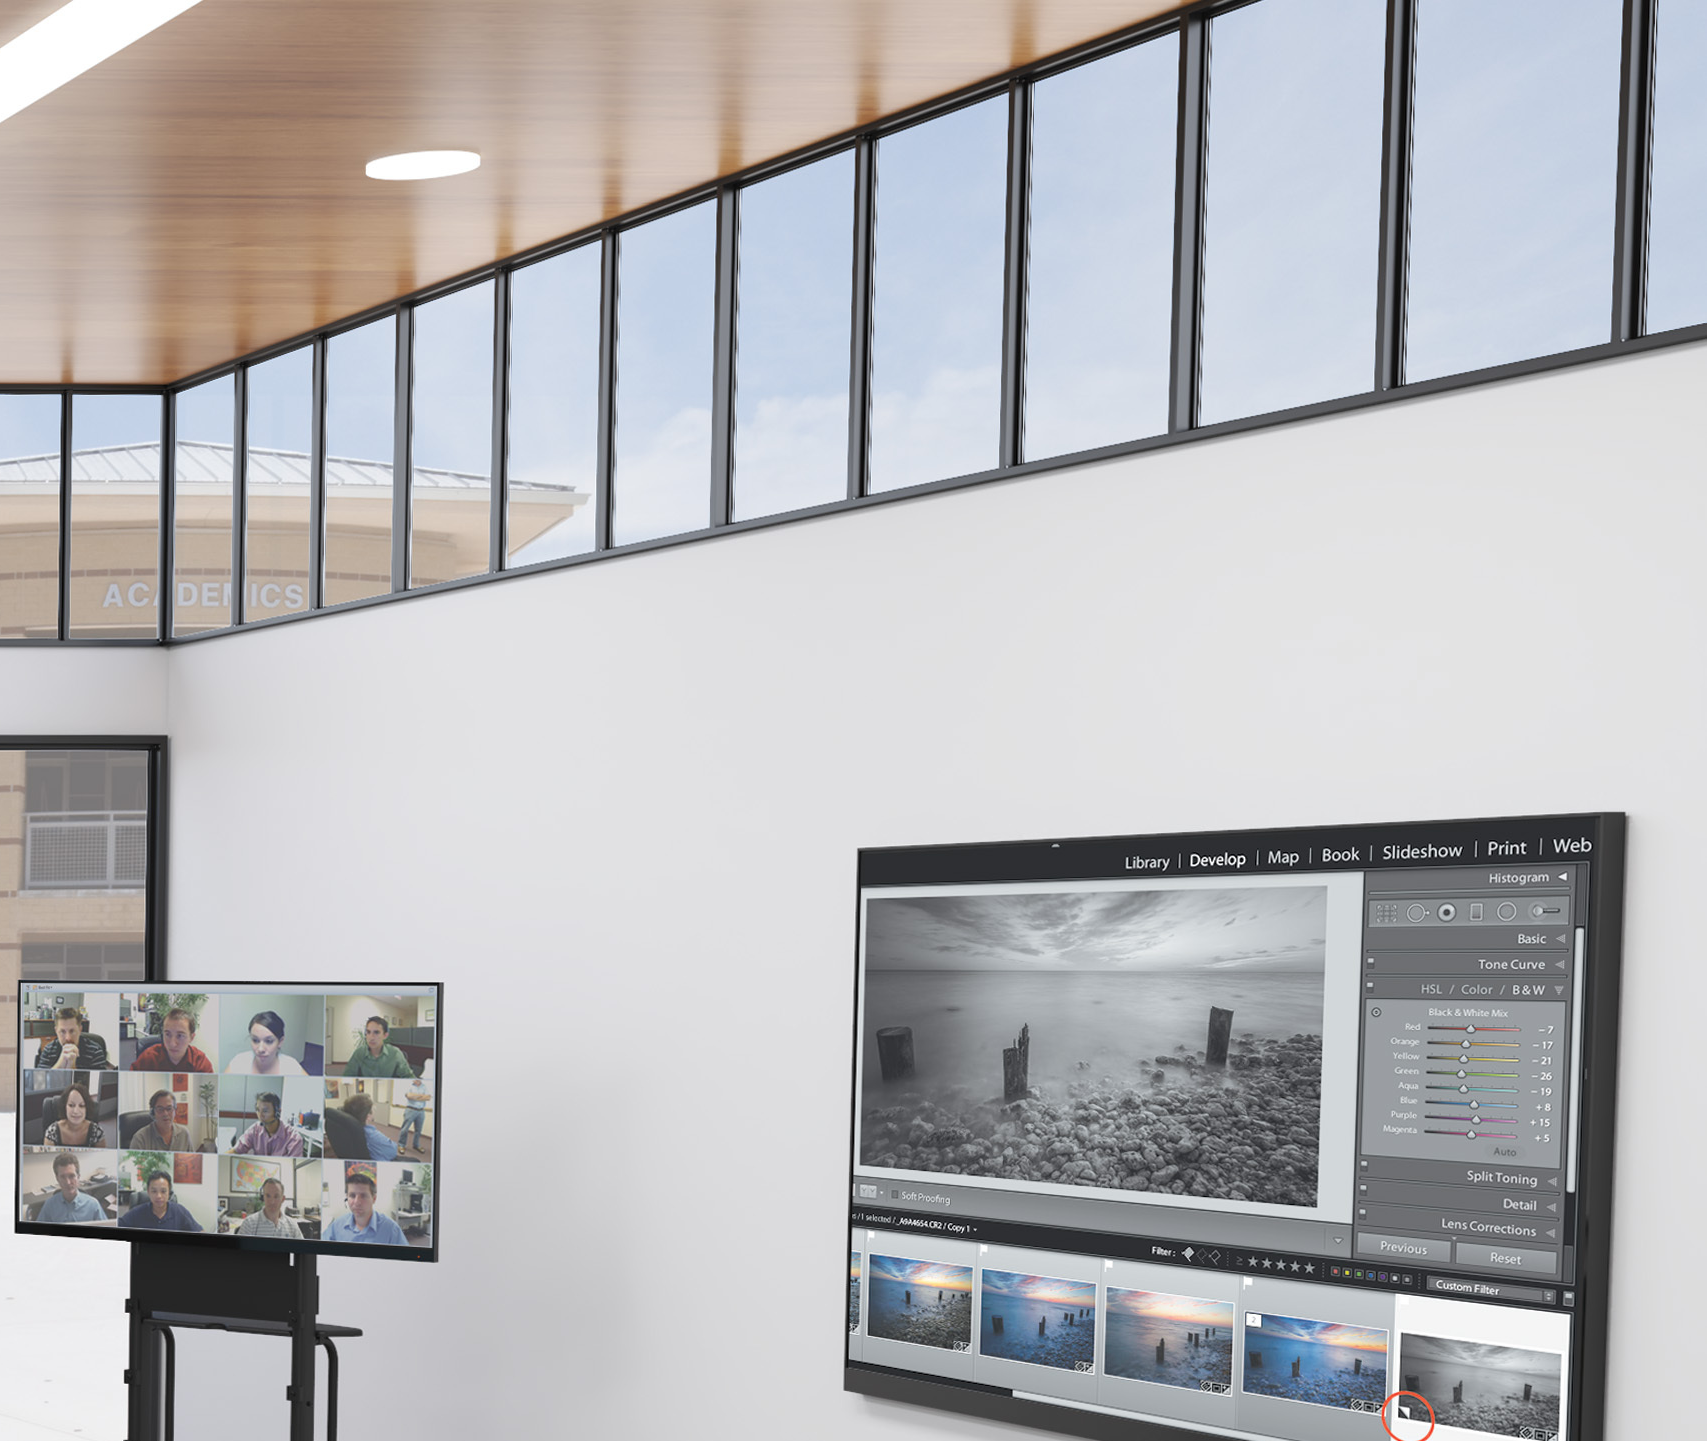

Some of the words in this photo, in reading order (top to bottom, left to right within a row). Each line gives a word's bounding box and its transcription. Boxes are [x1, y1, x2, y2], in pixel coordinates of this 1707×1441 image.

[102, 581, 304, 608] ACDEICS
[1125, 853, 1170, 871] Library
[1189, 851, 1246, 871] Develop
[1268, 849, 1299, 868] Map
[1322, 847, 1360, 863] Book
[1382, 843, 1463, 860] Slideshow
[1488, 839, 1527, 856] Print
[1553, 837, 1592, 853] Web
[1489, 870, 1550, 886] Histogram
[1517, 932, 1547, 945] Basic
[1478, 958, 1507, 971] Tone
[1510, 958, 1546, 971] Curve
[1421, 984, 1443, 995] HSL
[1461, 984, 1493, 995] Color
[1428, 1008, 1453, 1017] Black
[1463, 1009, 1489, 1018] White
[1491, 1009, 1509, 1018] Mix
[1405, 1023, 1421, 1031] Red
[1390, 1037, 1421, 1047] Orange
[1393, 1052, 1420, 1061] Yellow
[1394, 1066, 1420, 1075] Green
[1398, 1082, 1419, 1091] Aqua
[1400, 1096, 1418, 1105] Blue
[1391, 1111, 1417, 1121] Purple
[1383, 1124, 1418, 1136] Magenta
[1493, 1147, 1517, 1157] Auto
[1467, 1169, 1494, 1185] Split
[1495, 1172, 1538, 1188] Toning
[901, 1191, 917, 1201] Soft
[918, 1193, 951, 1206] Proofing
[1503, 1198, 1537, 1211] Detail
[866, 1214, 891, 1223] selected
[947, 1222, 965, 1233] Copy
[1442, 1218, 1467, 1231] Lens
[1469, 1221, 1537, 1237] Corrections
[1380, 1240, 1428, 1256] Previous
[1490, 1252, 1522, 1266] Reset
[1436, 1280, 1472, 1293] Custom
[1474, 1284, 1500, 1296] Filter
